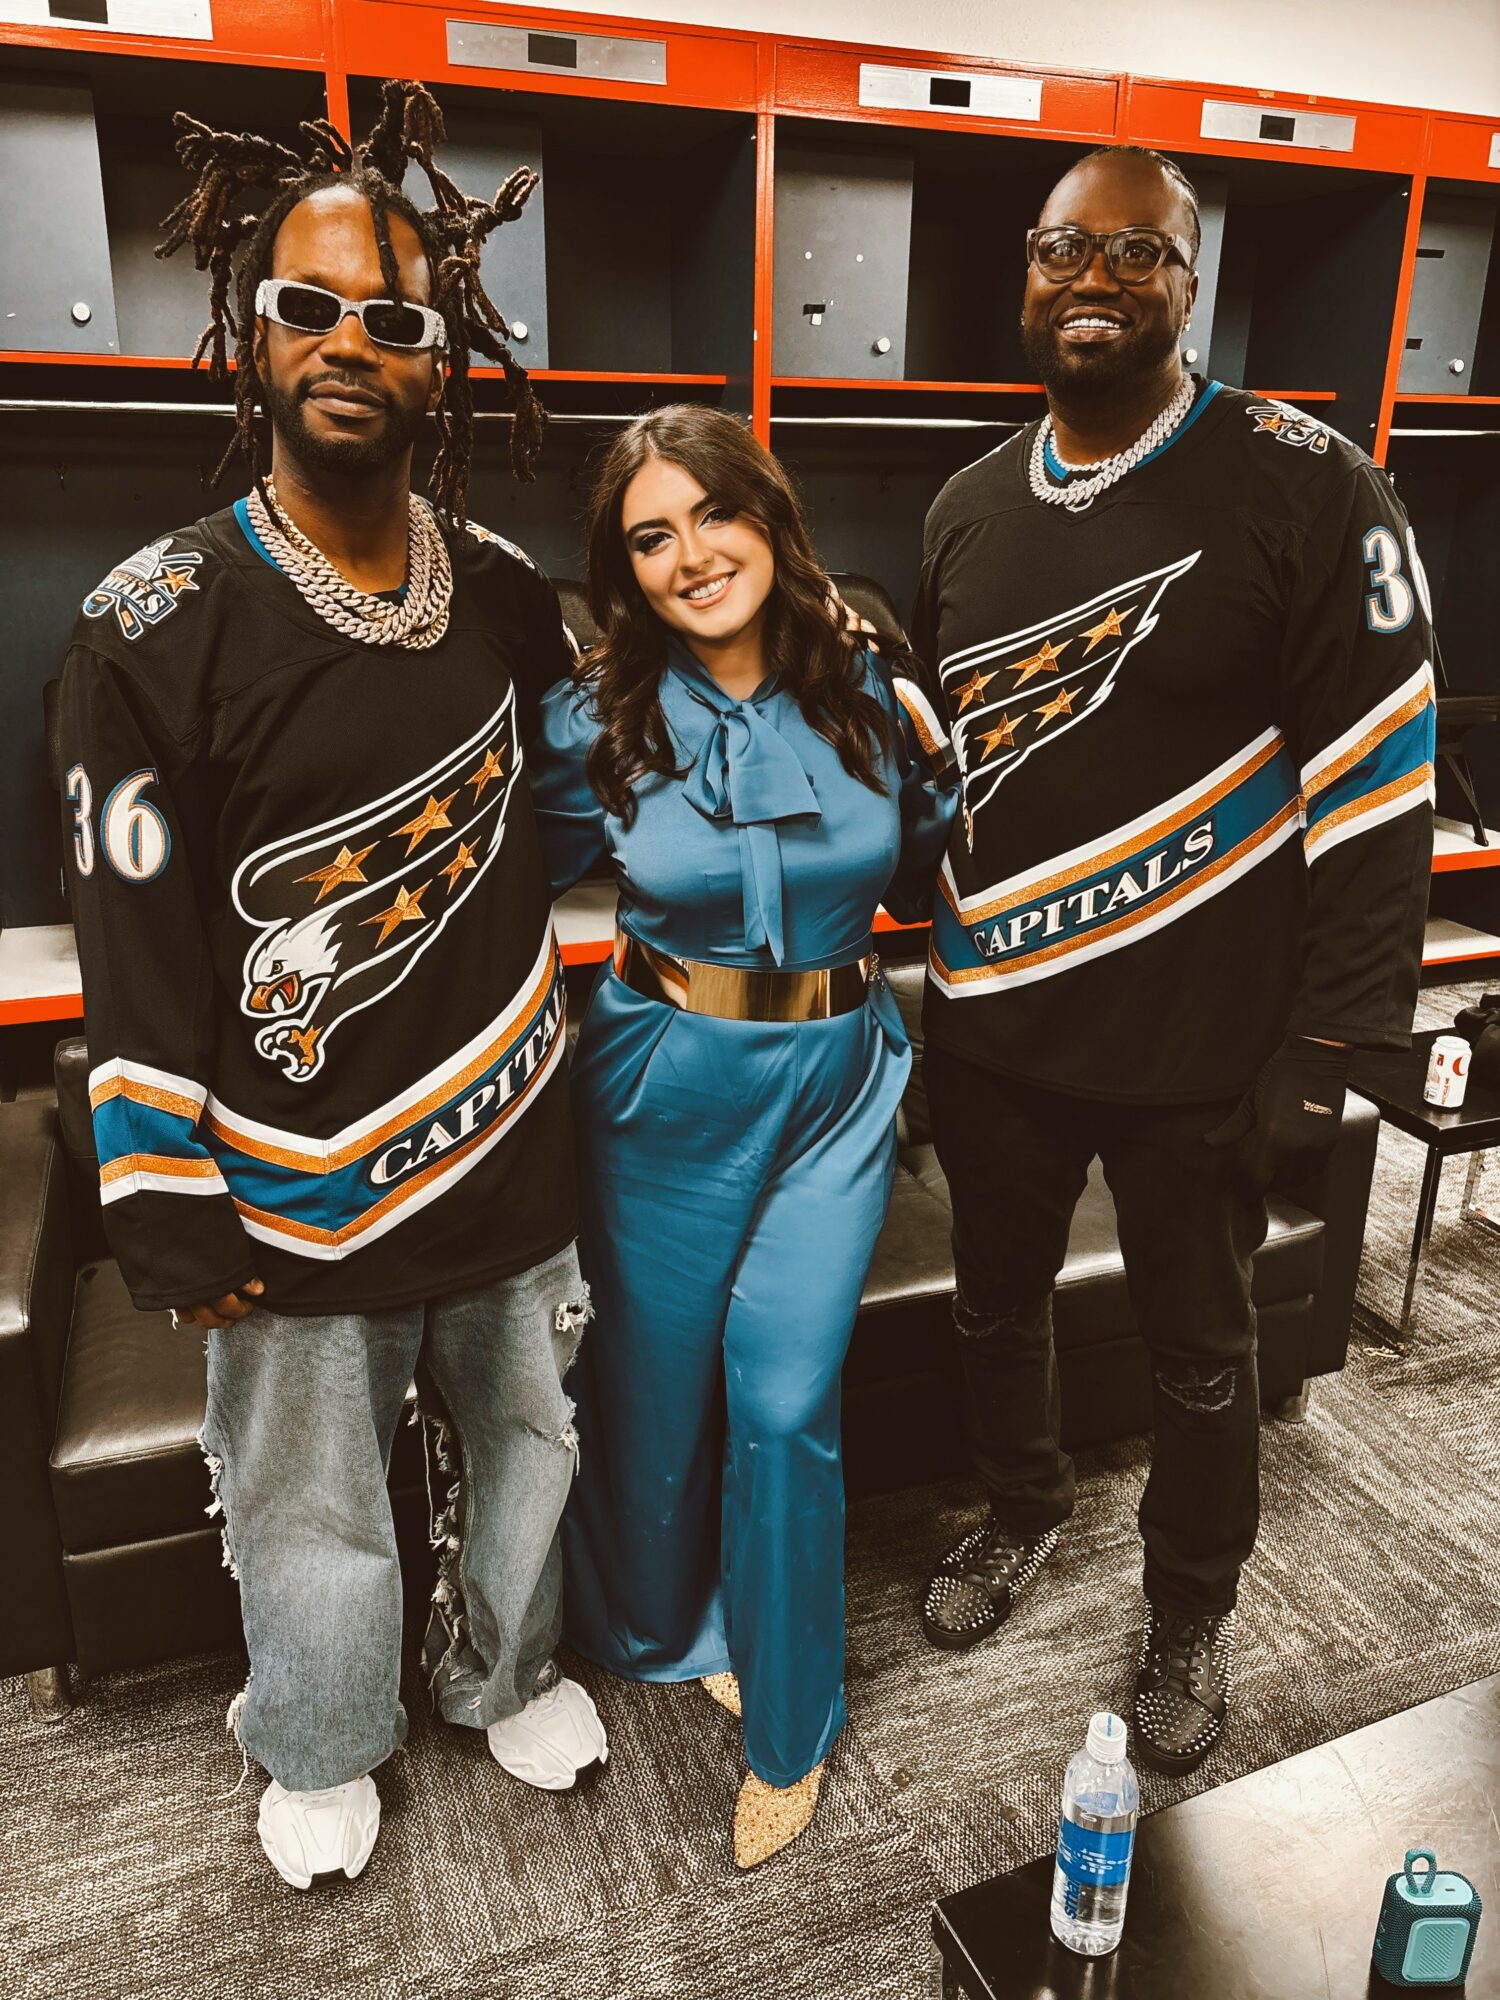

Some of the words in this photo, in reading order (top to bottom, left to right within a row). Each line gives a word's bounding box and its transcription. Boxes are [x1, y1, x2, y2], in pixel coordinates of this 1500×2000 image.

[66, 762, 171, 884] 36
[973, 820, 1214, 958] CAPITALS
[370, 952, 564, 1185] CAPITAL
